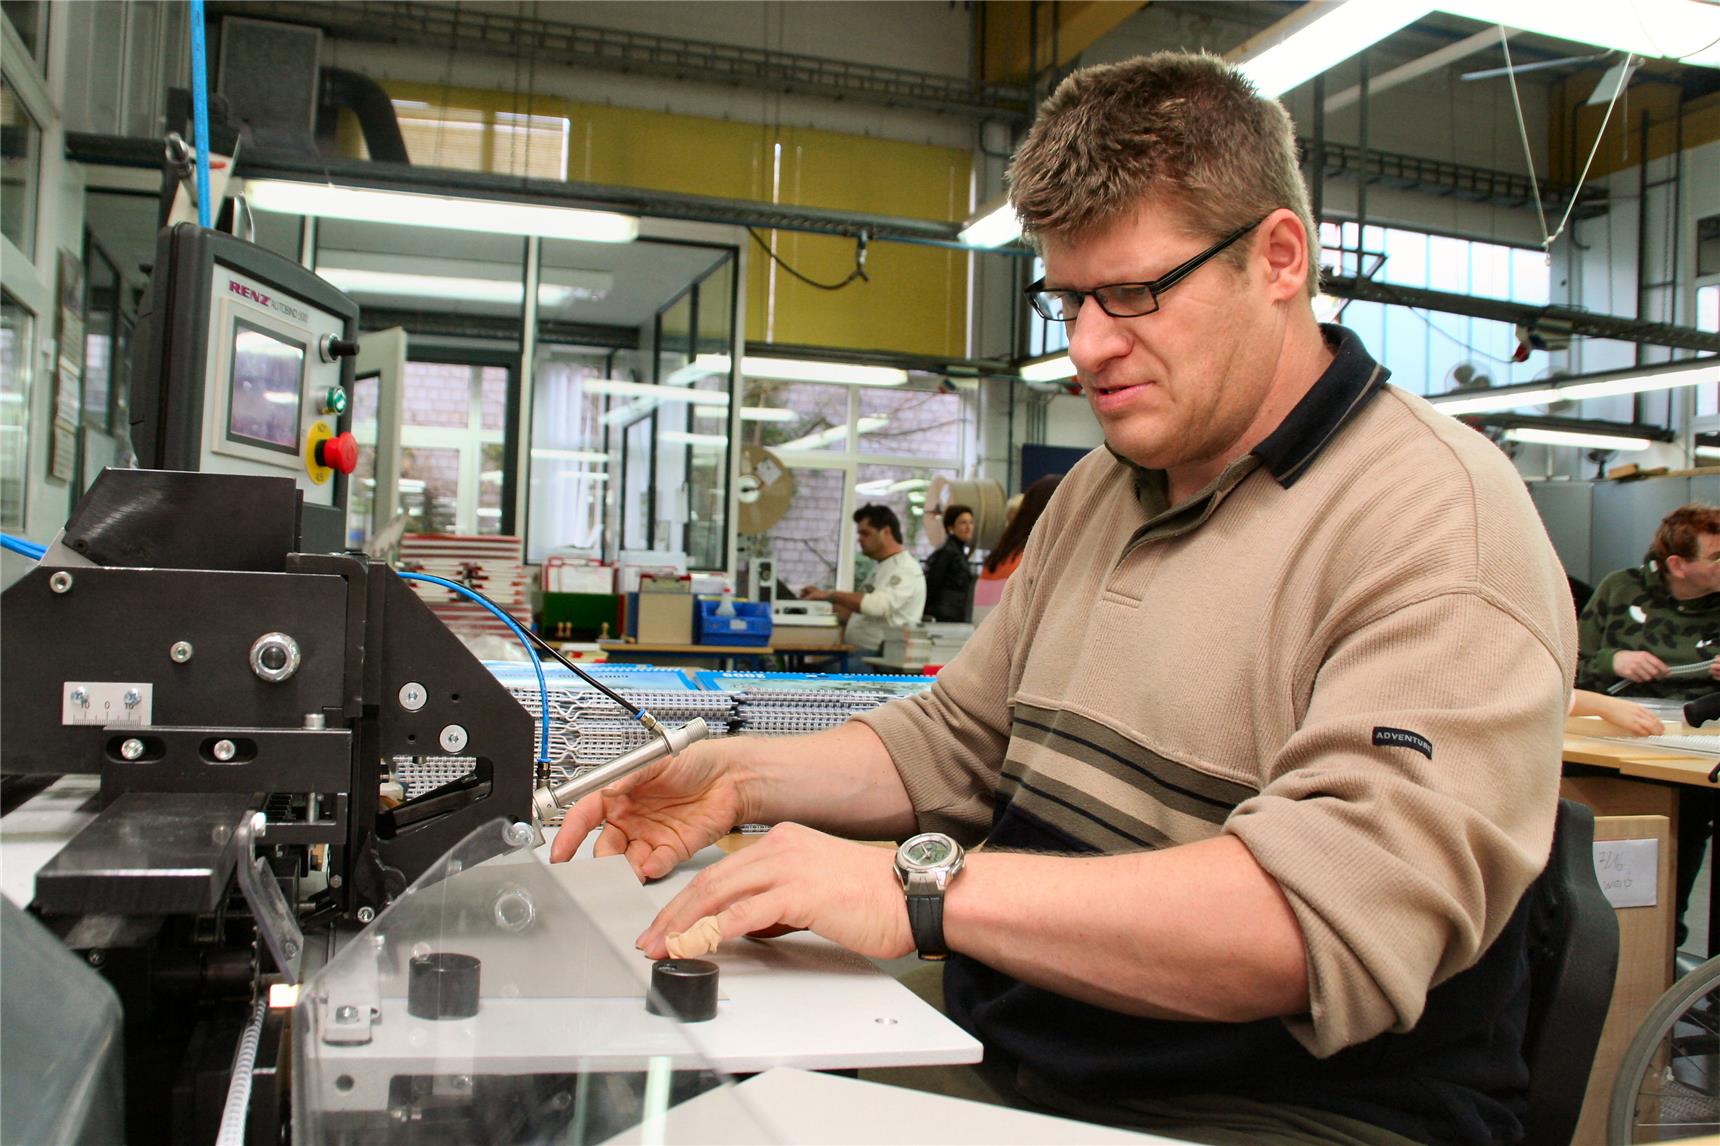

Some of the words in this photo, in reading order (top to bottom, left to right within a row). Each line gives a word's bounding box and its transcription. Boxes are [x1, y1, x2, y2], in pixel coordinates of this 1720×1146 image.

[229, 280, 270, 307] RENZ
[104, 701, 111, 709] 0
[1376, 732, 1431, 753] ADVENTURE
